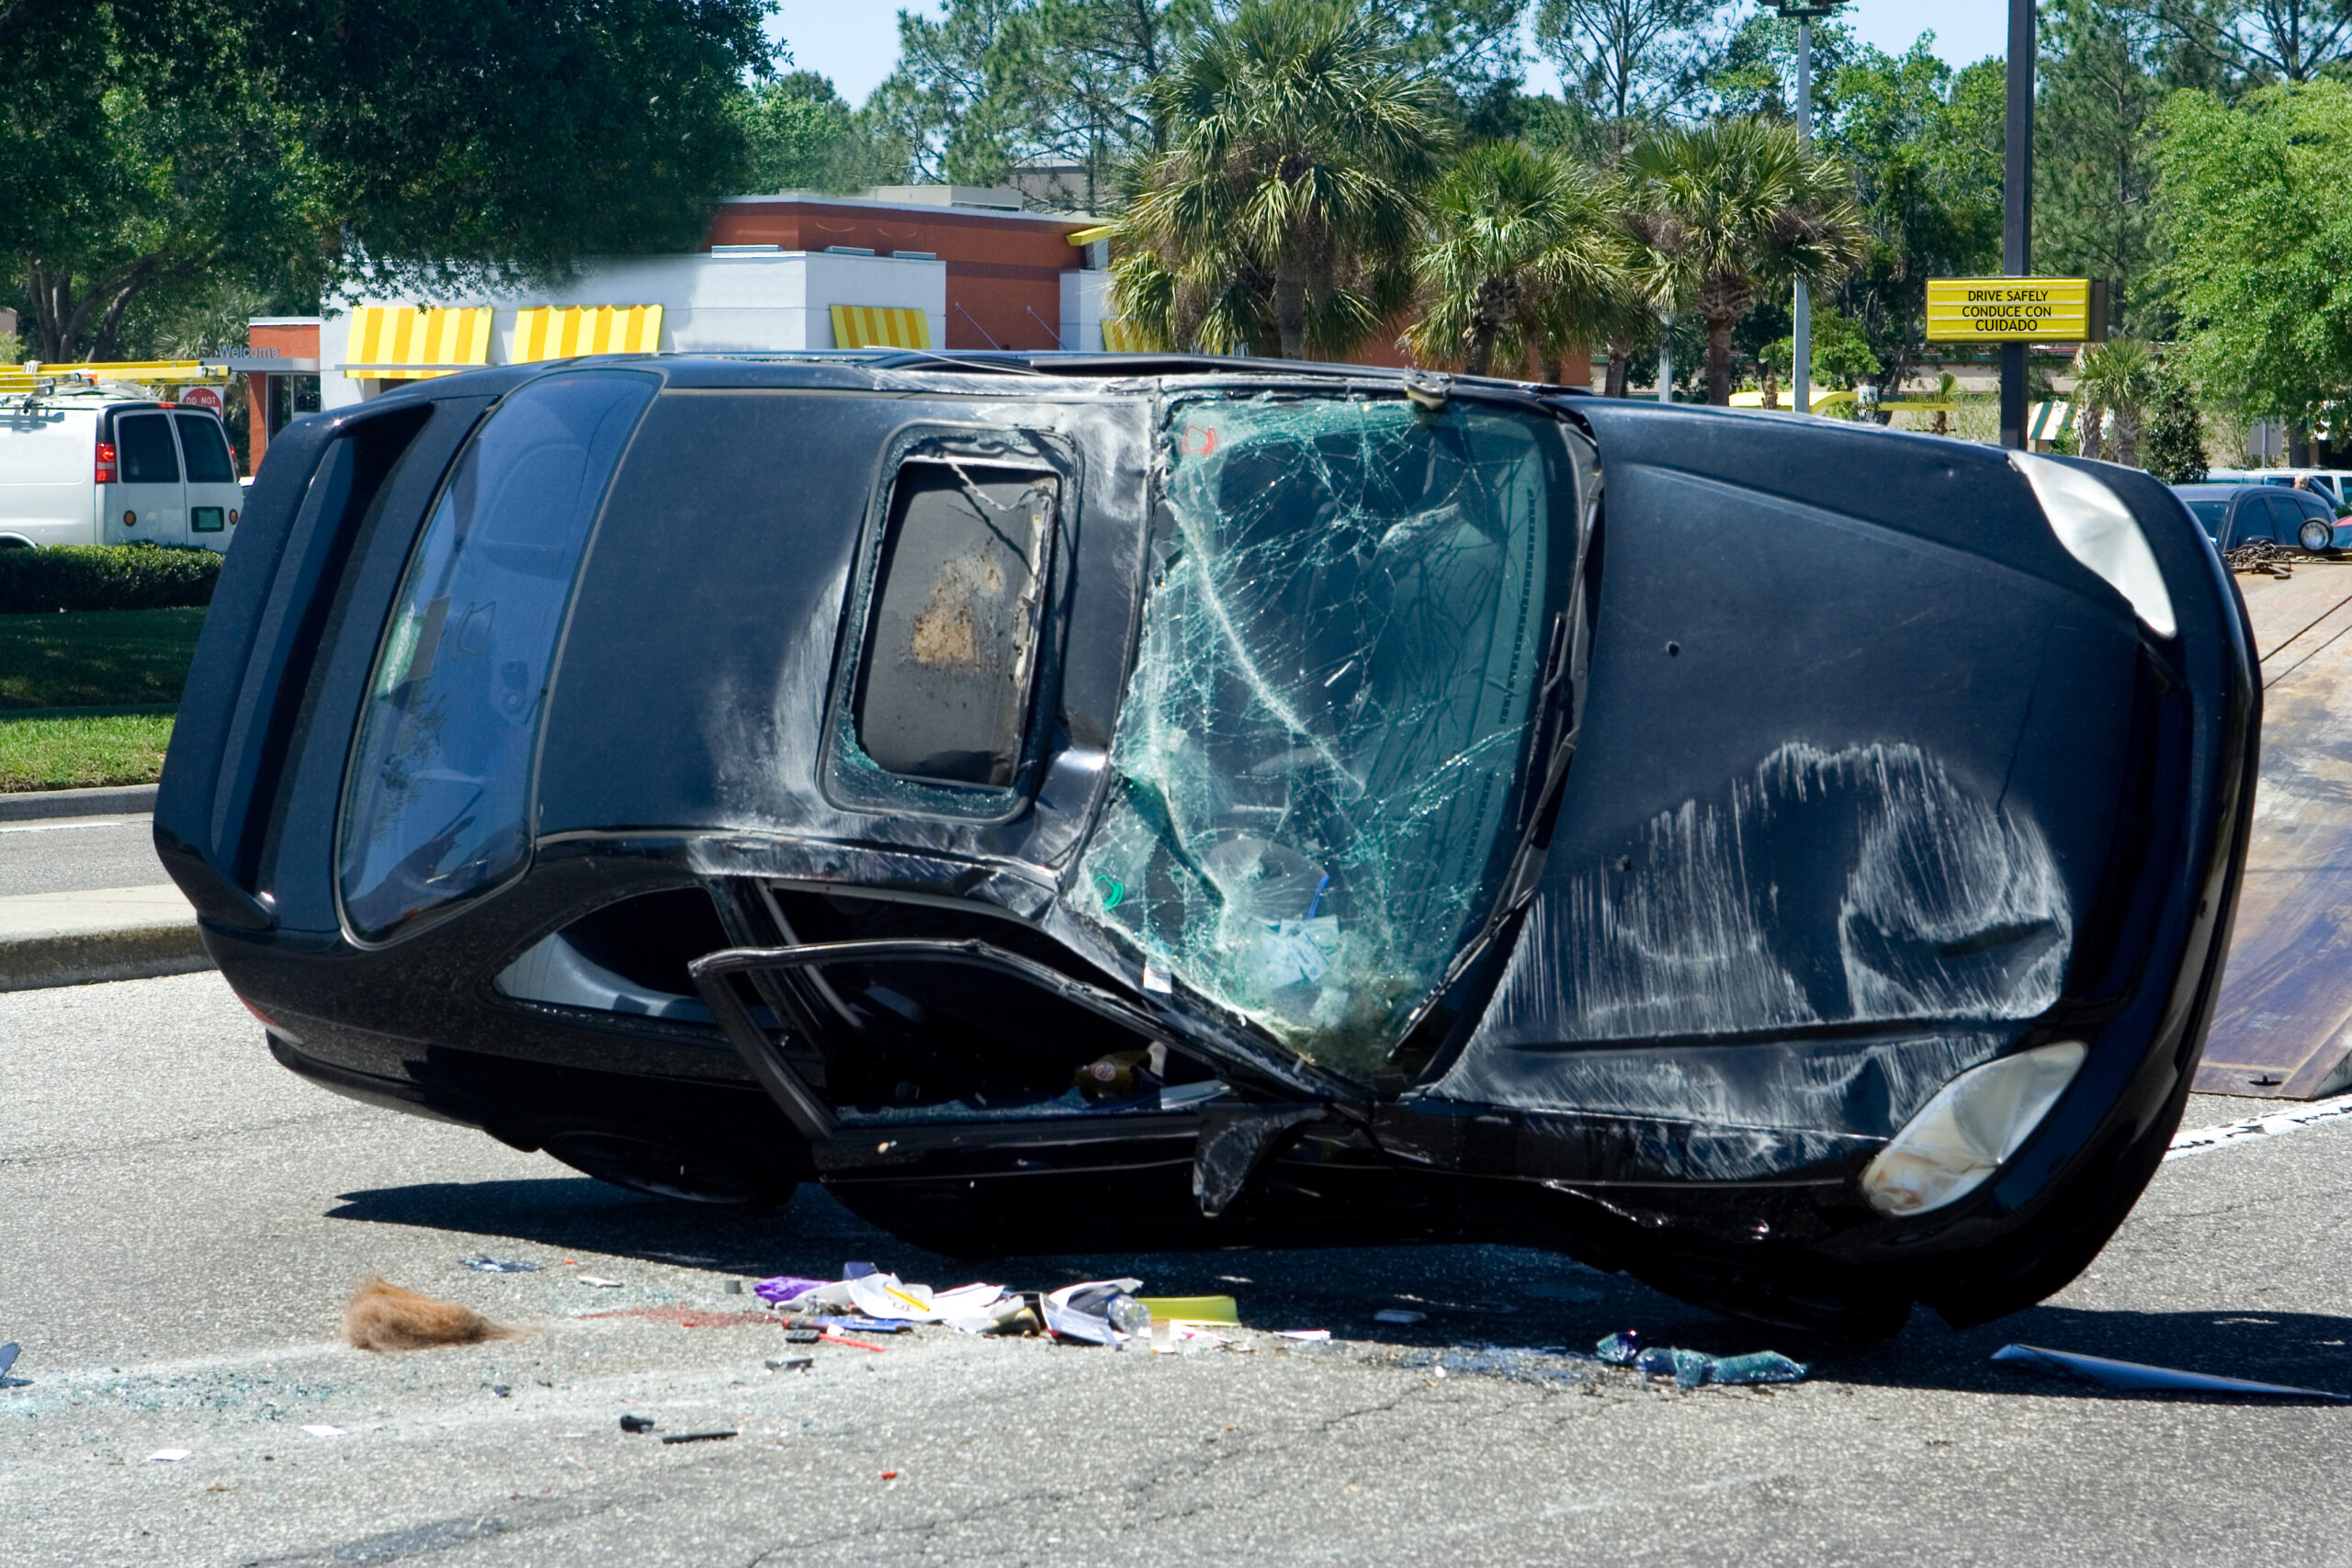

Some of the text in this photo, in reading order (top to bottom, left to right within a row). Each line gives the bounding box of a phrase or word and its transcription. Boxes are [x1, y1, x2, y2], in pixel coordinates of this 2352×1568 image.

[1968, 290, 2049, 301] DRIVE SAFELY
[1962, 306, 2052, 317] CONDUCE CON
[1975, 319, 2038, 332] CUIDADO
[218, 344, 279, 359] Welcome
[187, 396, 216, 404] DO NOT
